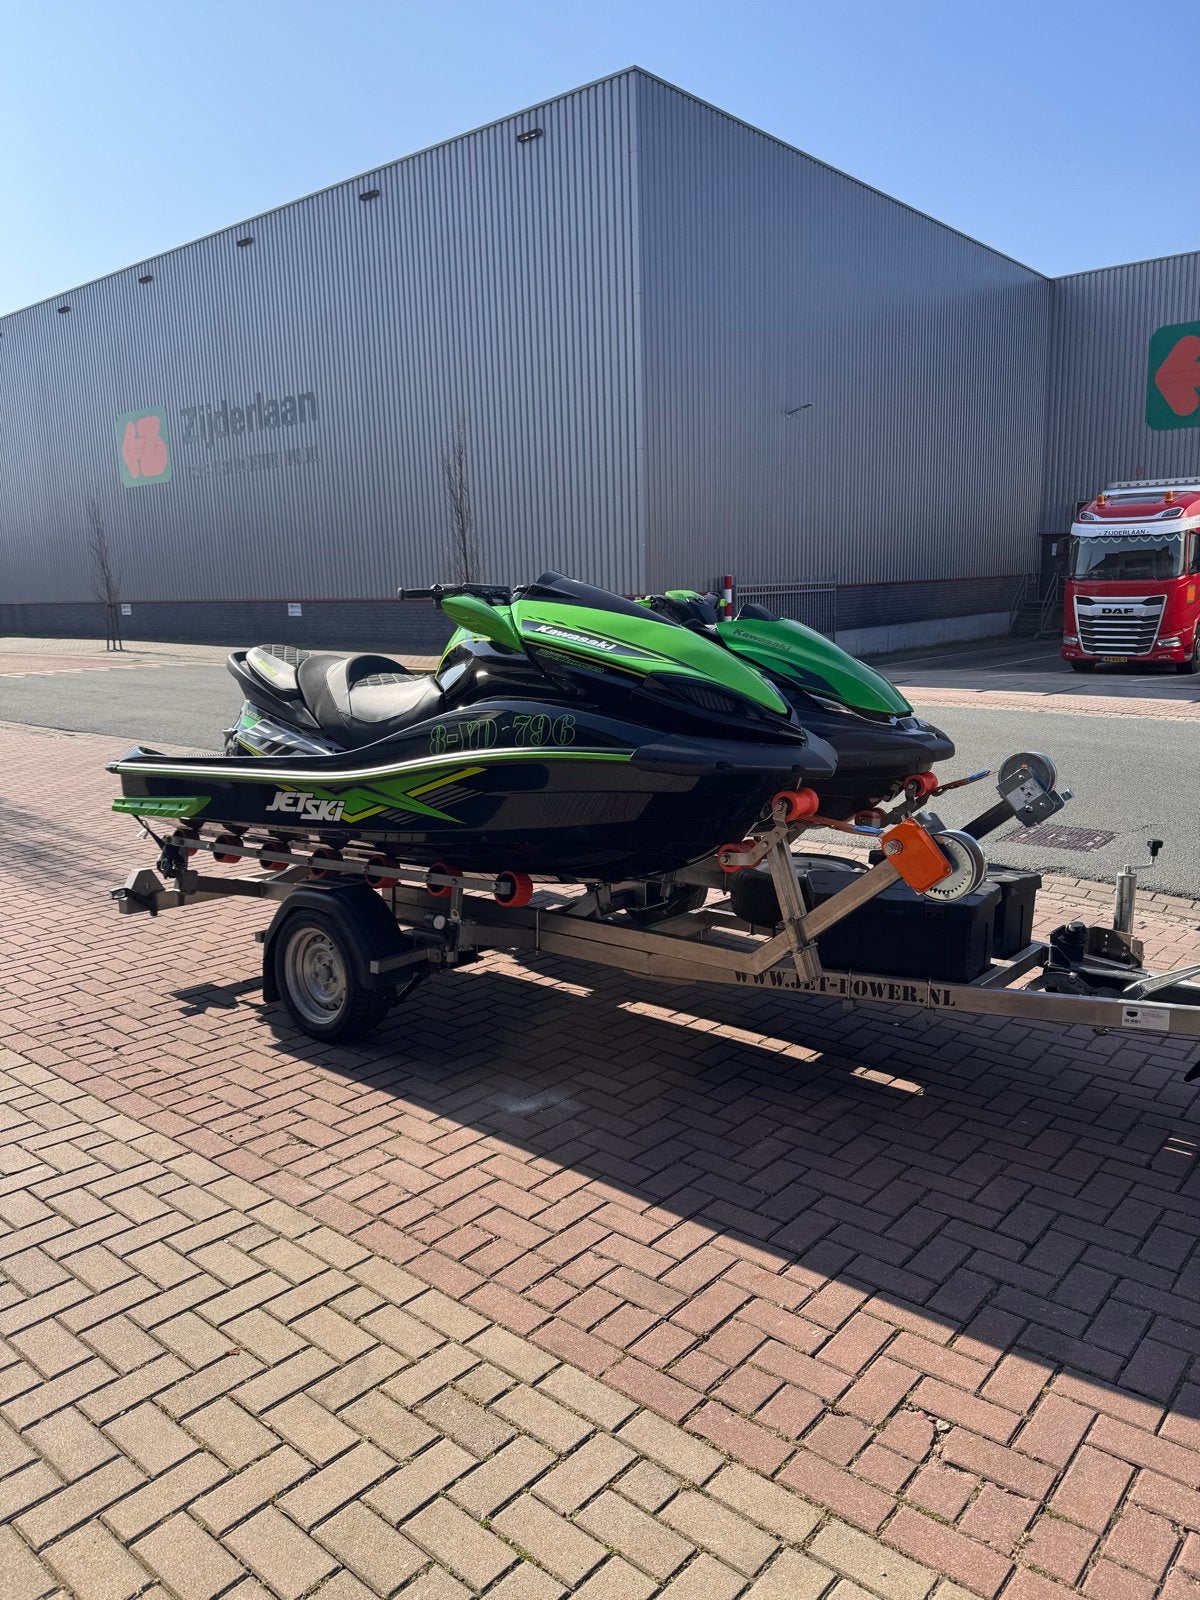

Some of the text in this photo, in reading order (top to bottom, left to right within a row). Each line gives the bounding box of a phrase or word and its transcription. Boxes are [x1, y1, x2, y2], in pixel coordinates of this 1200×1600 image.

[180, 391, 317, 448] Zijderlaan
[535, 625, 617, 651] Kawasaki
[733, 628, 793, 651] Kawasaki
